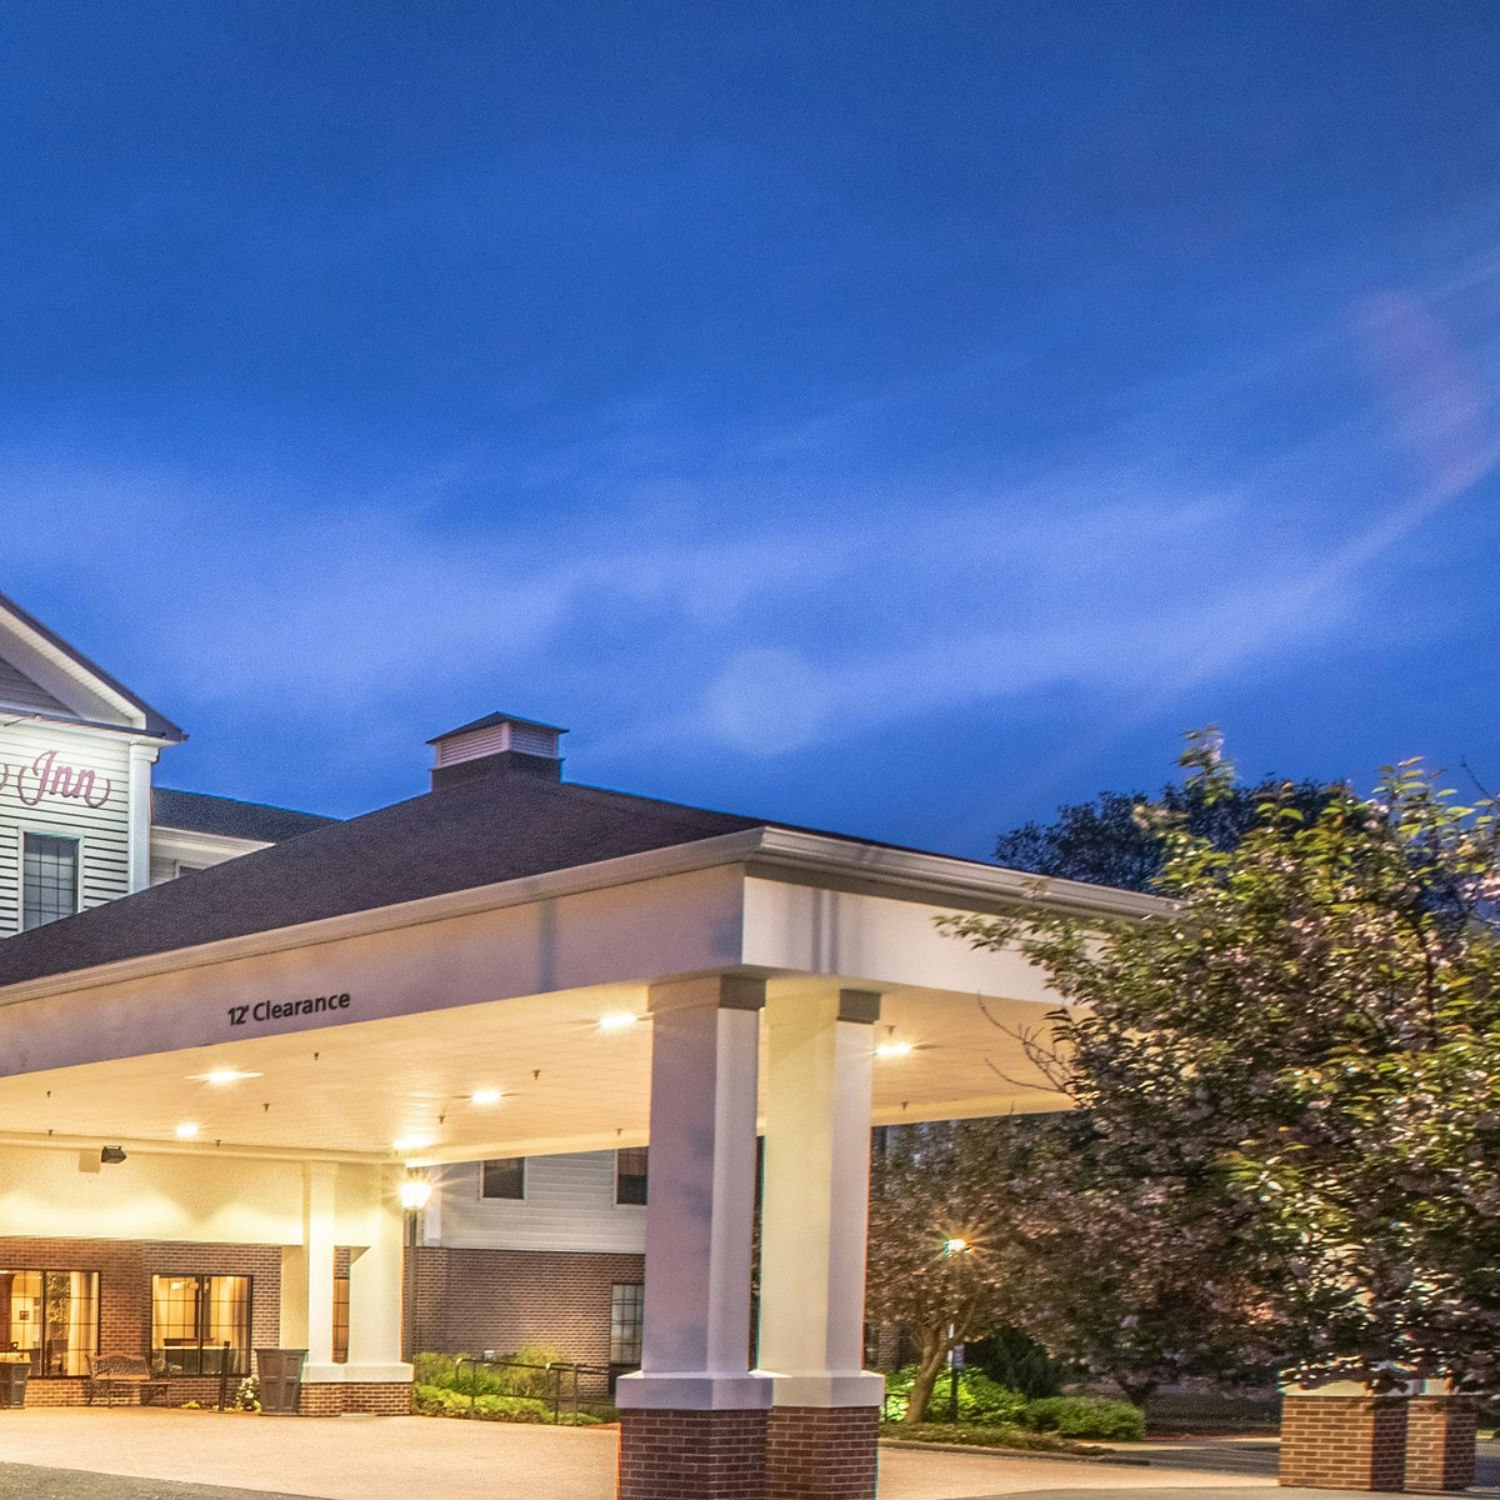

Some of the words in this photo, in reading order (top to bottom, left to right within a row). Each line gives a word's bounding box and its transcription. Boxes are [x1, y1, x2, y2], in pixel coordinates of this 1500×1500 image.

[17, 750, 111, 808] Inn
[227, 1004, 249, 1026] 12'
[252, 993, 350, 1022] Clearance
